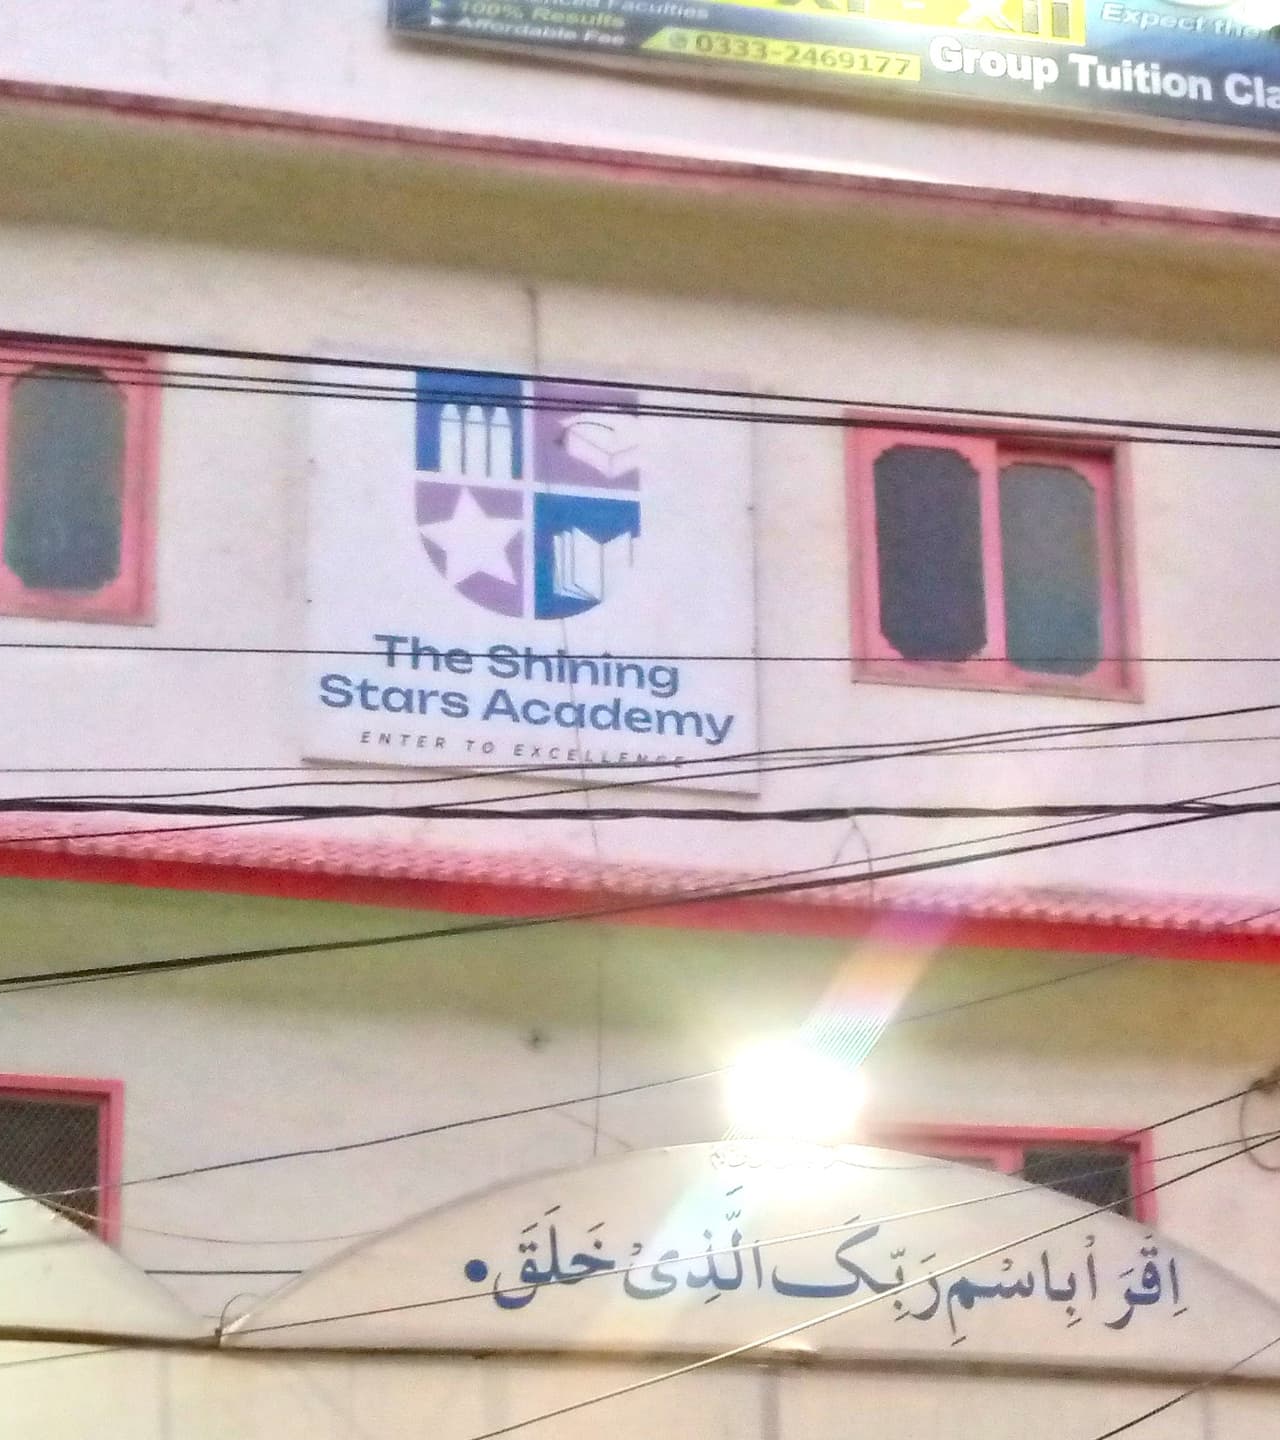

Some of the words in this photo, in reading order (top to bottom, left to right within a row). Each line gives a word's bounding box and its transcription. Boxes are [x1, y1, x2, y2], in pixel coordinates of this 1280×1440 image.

[1102, 2, 1208, 35] Expect
[694, 34, 913, 78] 0333-2469177
[928, 35, 1060, 91] Group
[1069, 51, 1214, 103] Tuition
[373, 633, 474, 676] The
[487, 642, 680, 699] Shining
[319, 673, 470, 721] Stars
[481, 687, 736, 747] Academy
[360, 730, 448, 751] ENTER
[466, 739, 496, 756] TO
